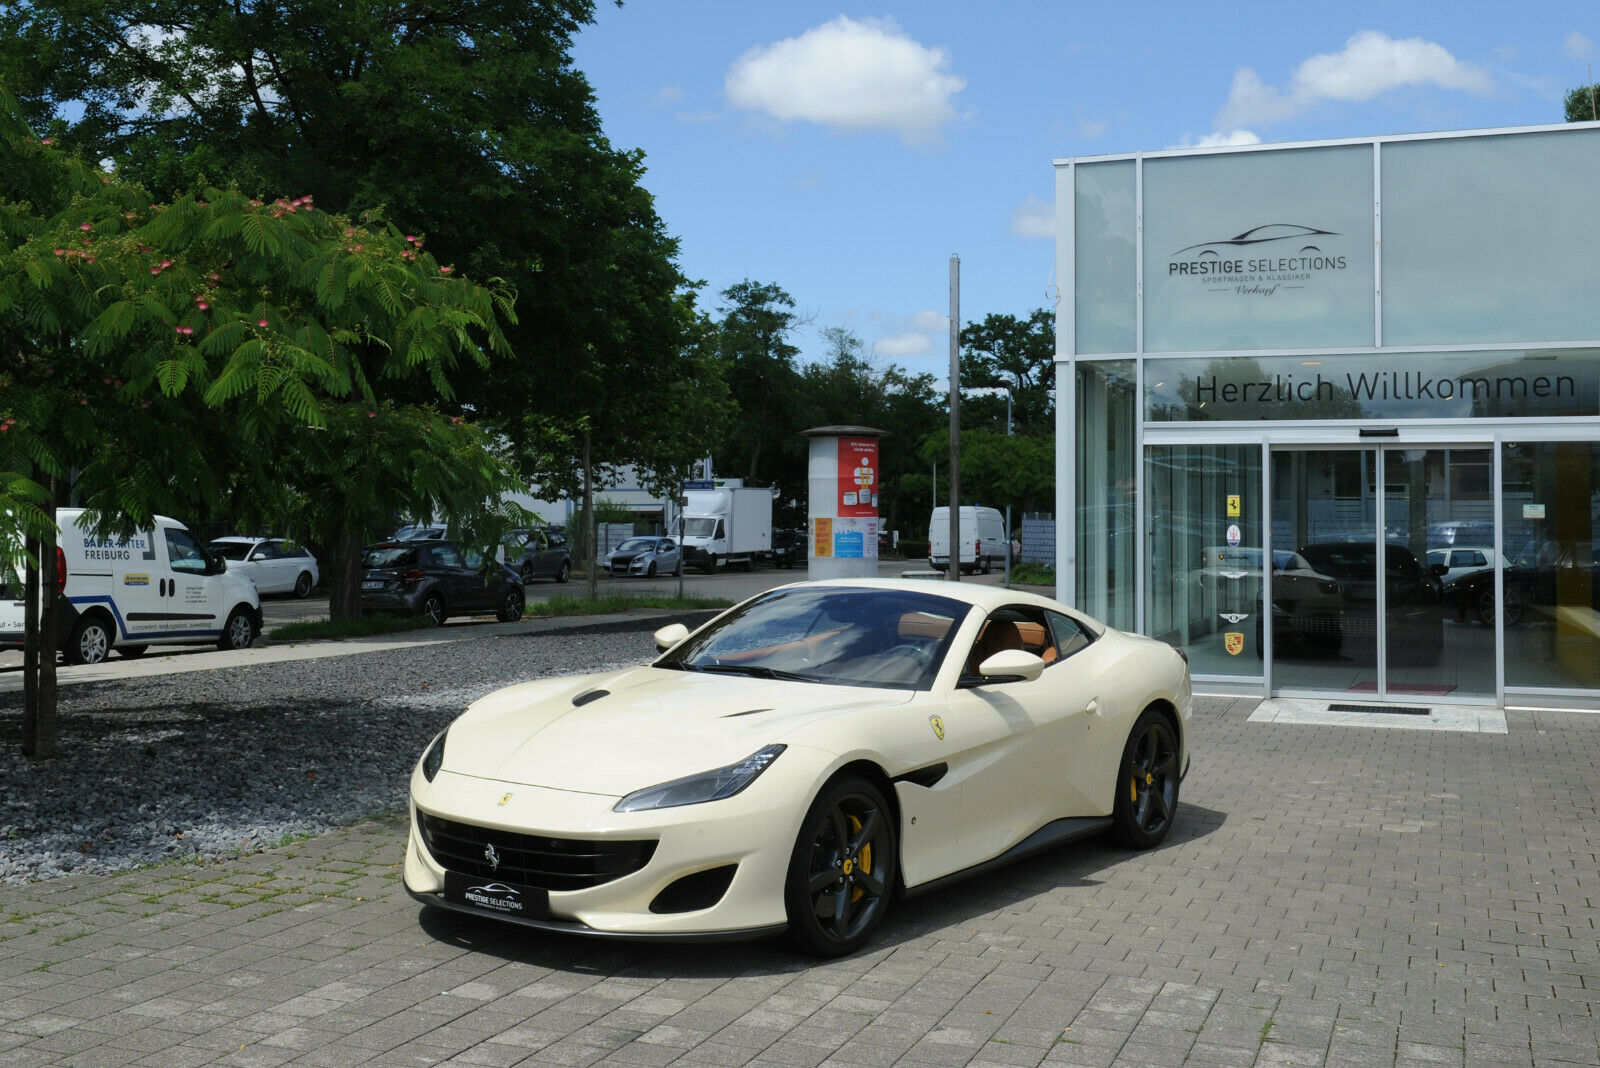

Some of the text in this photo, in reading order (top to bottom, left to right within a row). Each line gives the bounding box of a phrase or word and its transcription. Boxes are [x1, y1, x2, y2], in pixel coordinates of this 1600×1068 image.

[1169, 256, 1347, 276] PRESTIGE SELECTIONS
[1202, 275, 1255, 284] SPORTWAGEN
[1266, 273, 1311, 281] KLASSIKER
[1234, 284, 1281, 297] Verkauf
[1196, 371, 1575, 404] Herzlich Willkommen
[85, 550, 130, 560] FREIBURG
[465, 893, 489, 903] PRESTIGE
[490, 898, 522, 909] SELECTIONS
